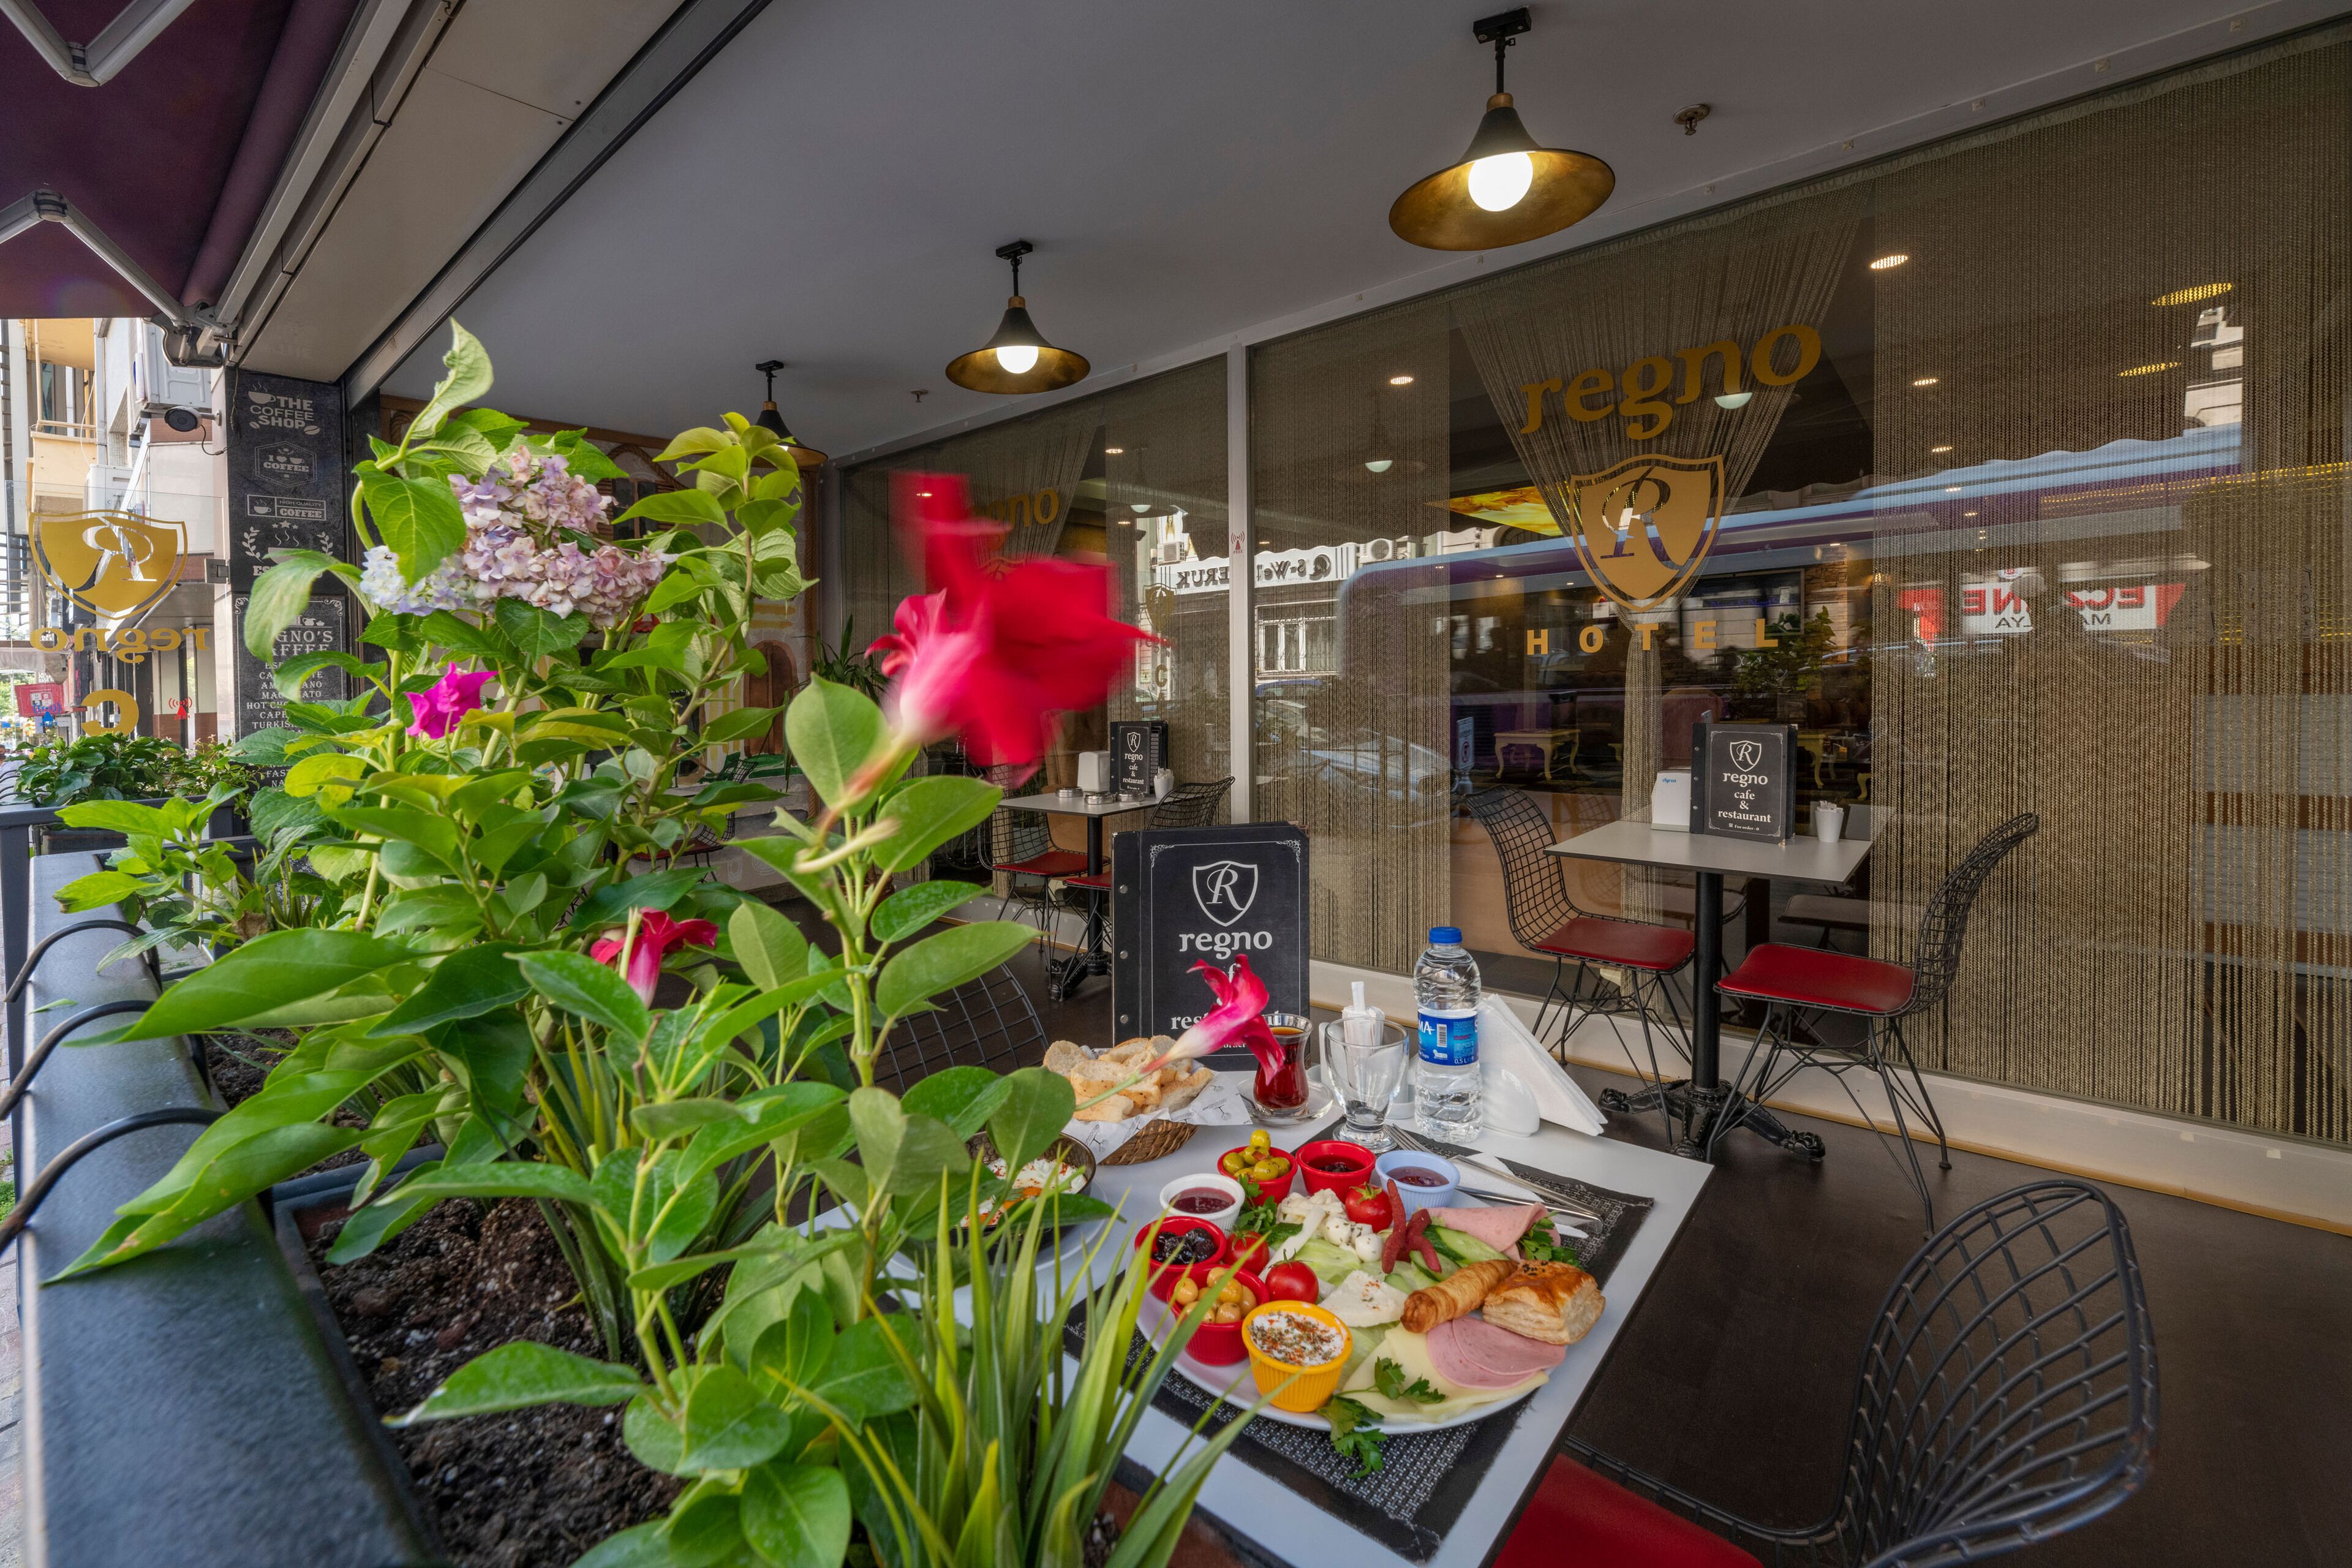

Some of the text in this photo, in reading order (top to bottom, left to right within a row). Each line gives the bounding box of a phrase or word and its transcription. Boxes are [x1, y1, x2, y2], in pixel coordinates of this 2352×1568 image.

[1521, 324, 1822, 440] regno
[276, 396, 313, 411] THE
[250, 405, 314, 421] COFFEE
[258, 415, 306, 429] SHOP
[263, 462, 309, 472] COFFEE
[279, 508, 323, 518] COFFEE
[1526, 618, 1779, 655] HOTEL
[1125, 753, 1143, 763] regno
[1722, 773, 1768, 787] regno
[1734, 790, 1755, 799] cafe
[1740, 800, 1749, 810] &
[1717, 810, 1771, 823] restaurant
[1178, 931, 1273, 960] regno
